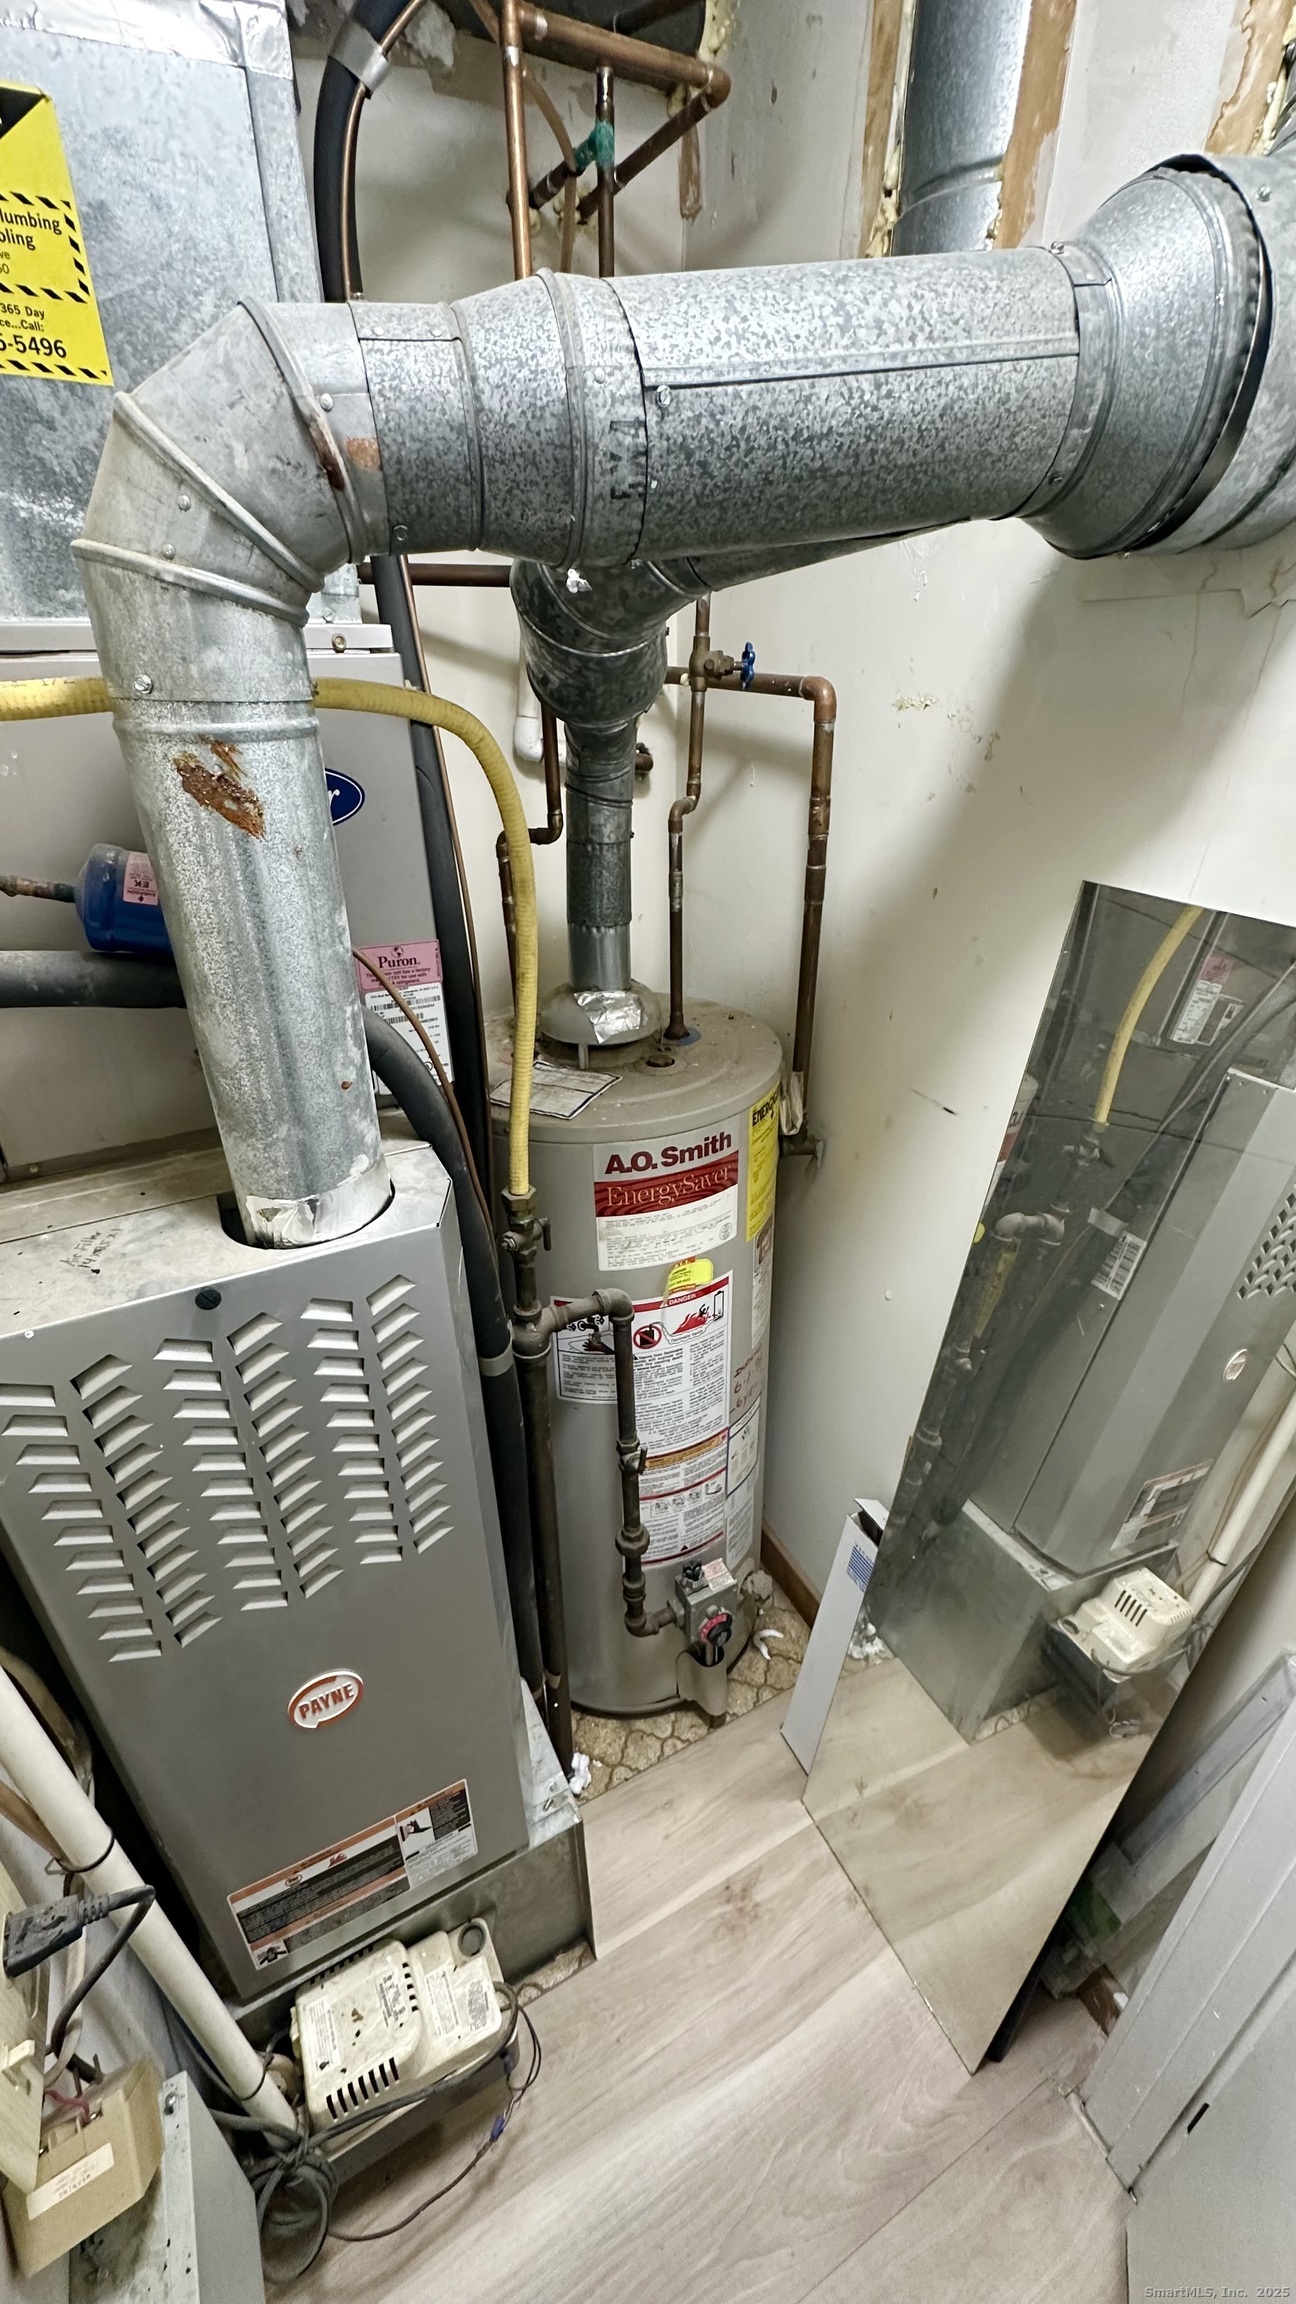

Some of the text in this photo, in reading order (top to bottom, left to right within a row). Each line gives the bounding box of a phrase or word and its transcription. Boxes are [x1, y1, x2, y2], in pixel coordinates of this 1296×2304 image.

[0, 302, 45, 320] 365 Day
[378, 956, 417, 969] Puron
[605, 1131, 732, 1175] A.O. Smith
[607, 1166, 730, 1206] EnergySaver
[668, 1293, 697, 1306] DANGER
[298, 1682, 355, 1720] PAYNE
